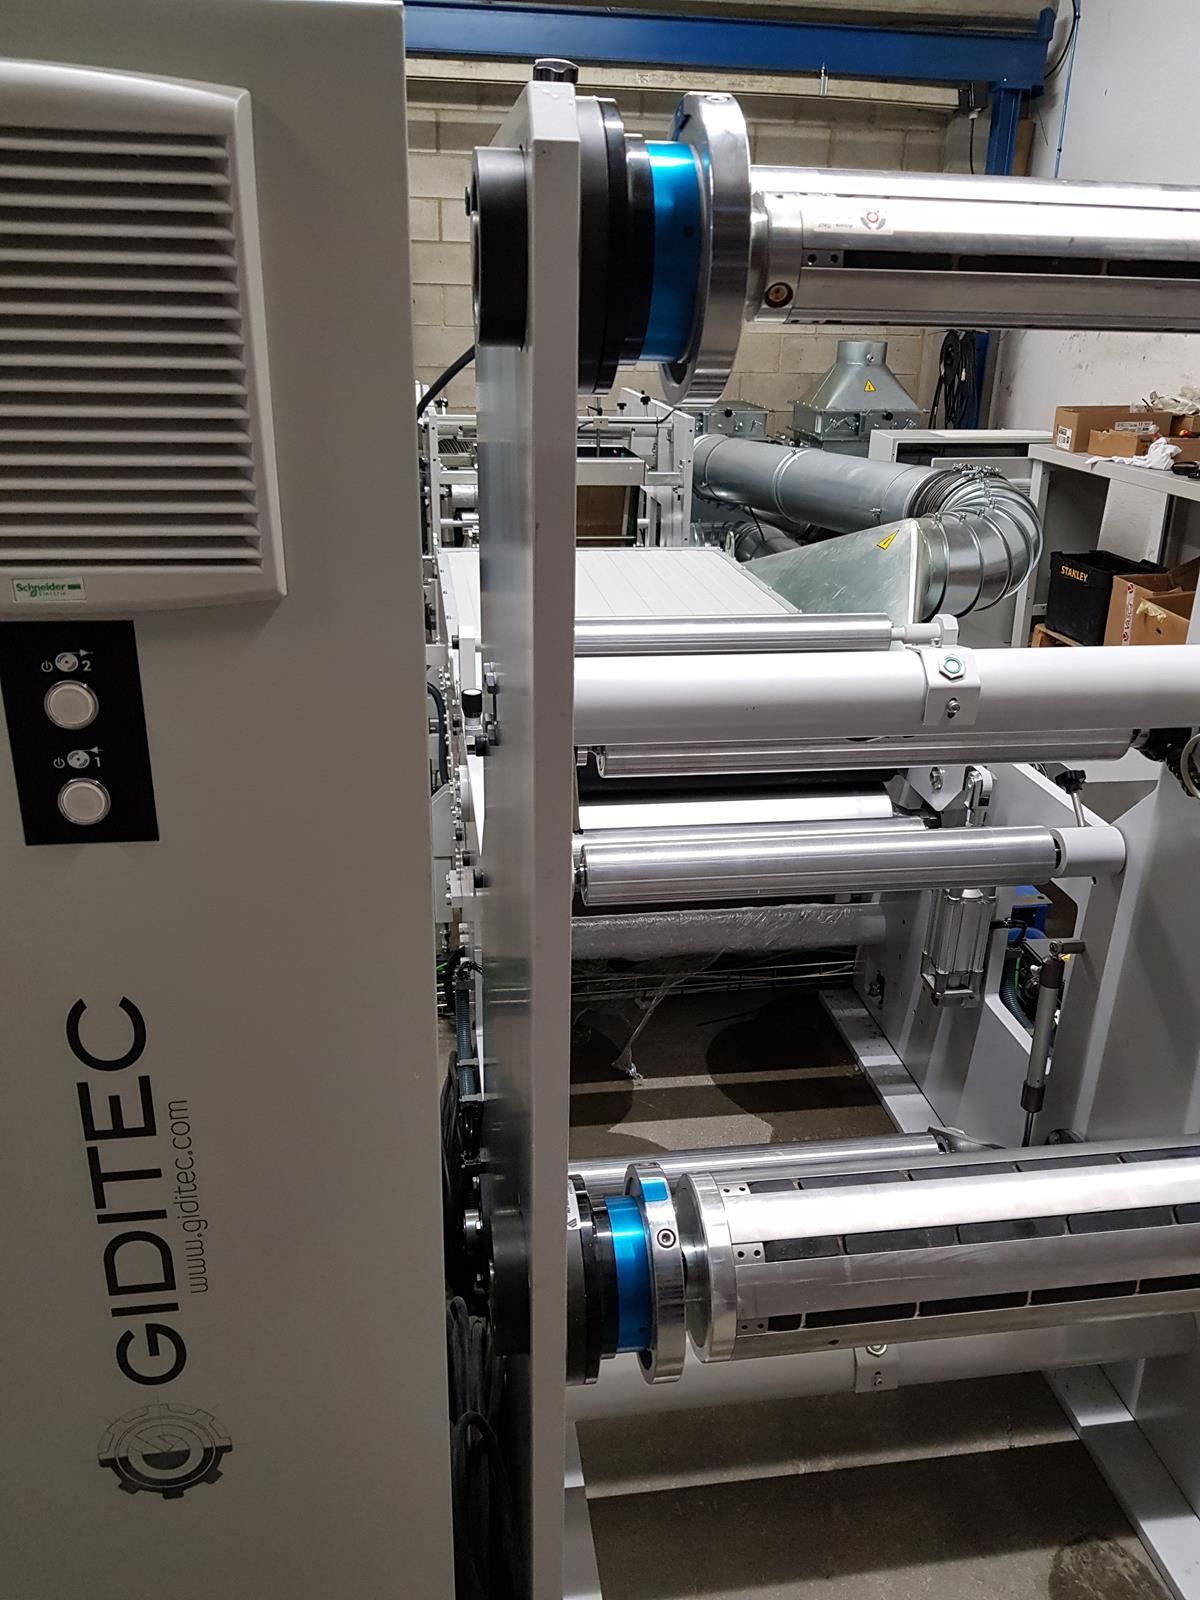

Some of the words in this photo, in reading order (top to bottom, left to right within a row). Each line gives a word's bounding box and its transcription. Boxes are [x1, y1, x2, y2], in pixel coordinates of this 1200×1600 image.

[1060, 565, 1089, 582] STANLEY
[16, 582, 66, 597] Schneider
[81, 660, 92, 672] 2
[94, 756, 101, 767] 1
[66, 996, 187, 1386] GIDITEC
[167, 1099, 208, 1294] www.giditec.com
